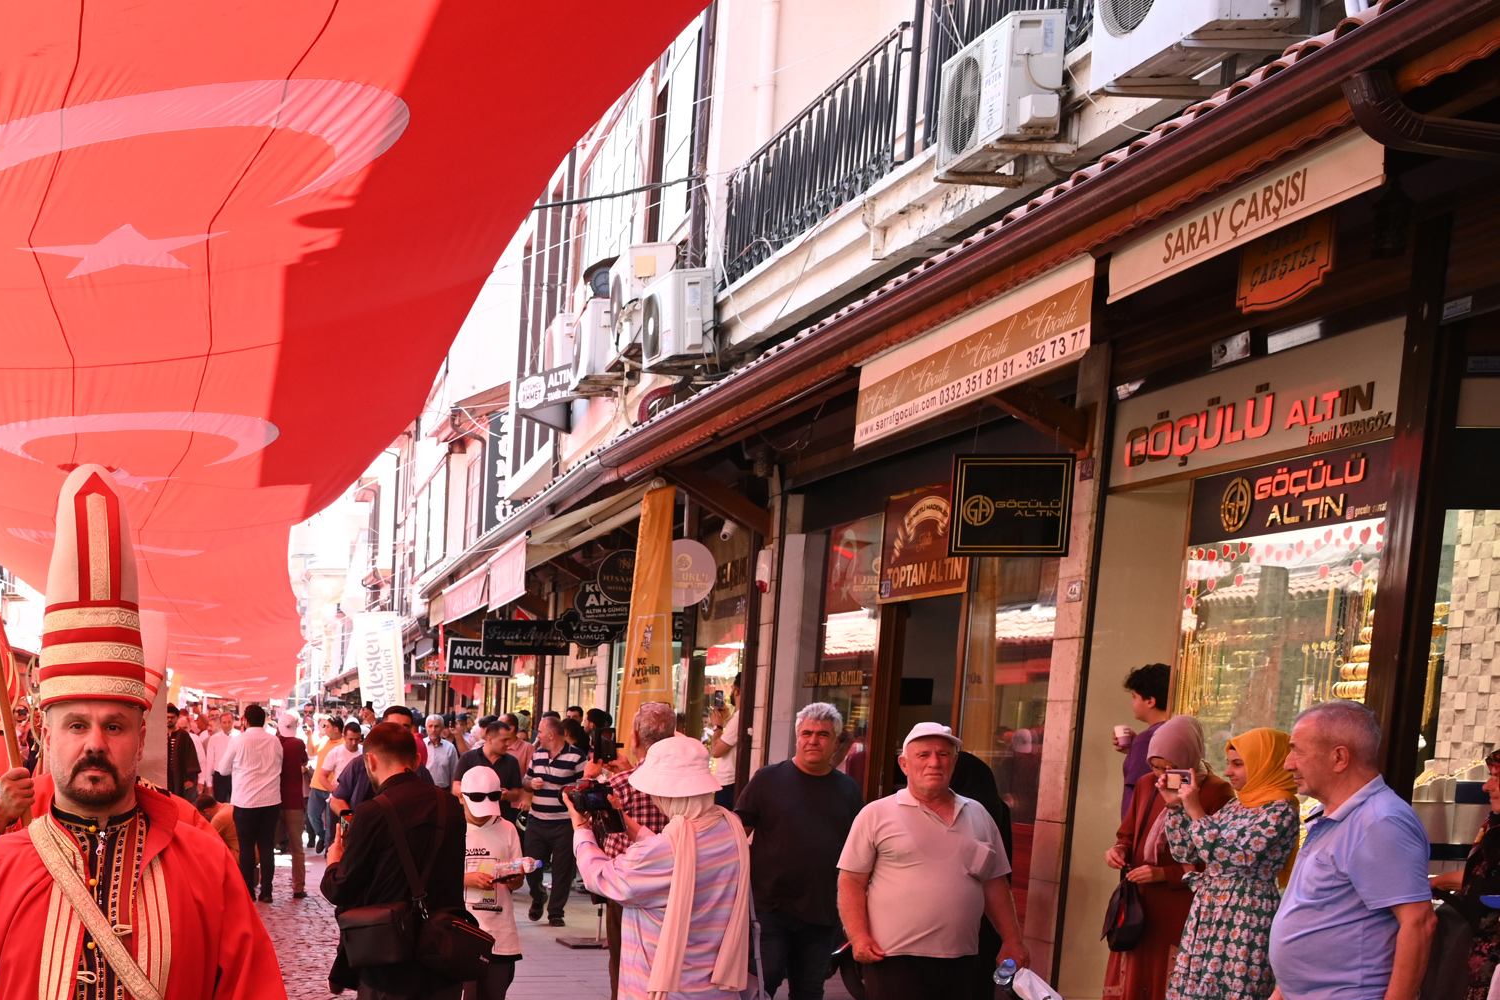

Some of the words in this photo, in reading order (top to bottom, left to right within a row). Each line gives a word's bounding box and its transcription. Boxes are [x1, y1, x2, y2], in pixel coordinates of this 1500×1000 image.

[1162, 207, 1225, 264] SARAY
[1228, 167, 1308, 239] ÇARŞISI
[1250, 241, 1322, 292] ÇARŞISI
[859, 395, 937, 438] www.sarrafgoculu.com
[939, 375, 982, 406] 0332.351
[985, 368, 998, 386] 81
[1002, 361, 1015, 380] 91
[1026, 344, 1046, 374] 352
[1050, 336, 1067, 360] 73
[1071, 328, 1086, 349] 77
[1124, 382, 1275, 467] GÖÇÜLÜ
[1284, 381, 1376, 430] ALTIN
[1307, 424, 1338, 446] İsmail
[1337, 410, 1393, 439] KARAGÖZ
[1254, 452, 1367, 500] GÖÇÜLÜ
[995, 499, 1062, 509] GÖÇÜLÜ
[1265, 493, 1346, 527] ALTIN
[886, 562, 929, 590] TOPTAN
[928, 556, 963, 584] ALTIN
[570, 621, 610, 633] VEGA
[452, 658, 509, 674] M.POÇAN
